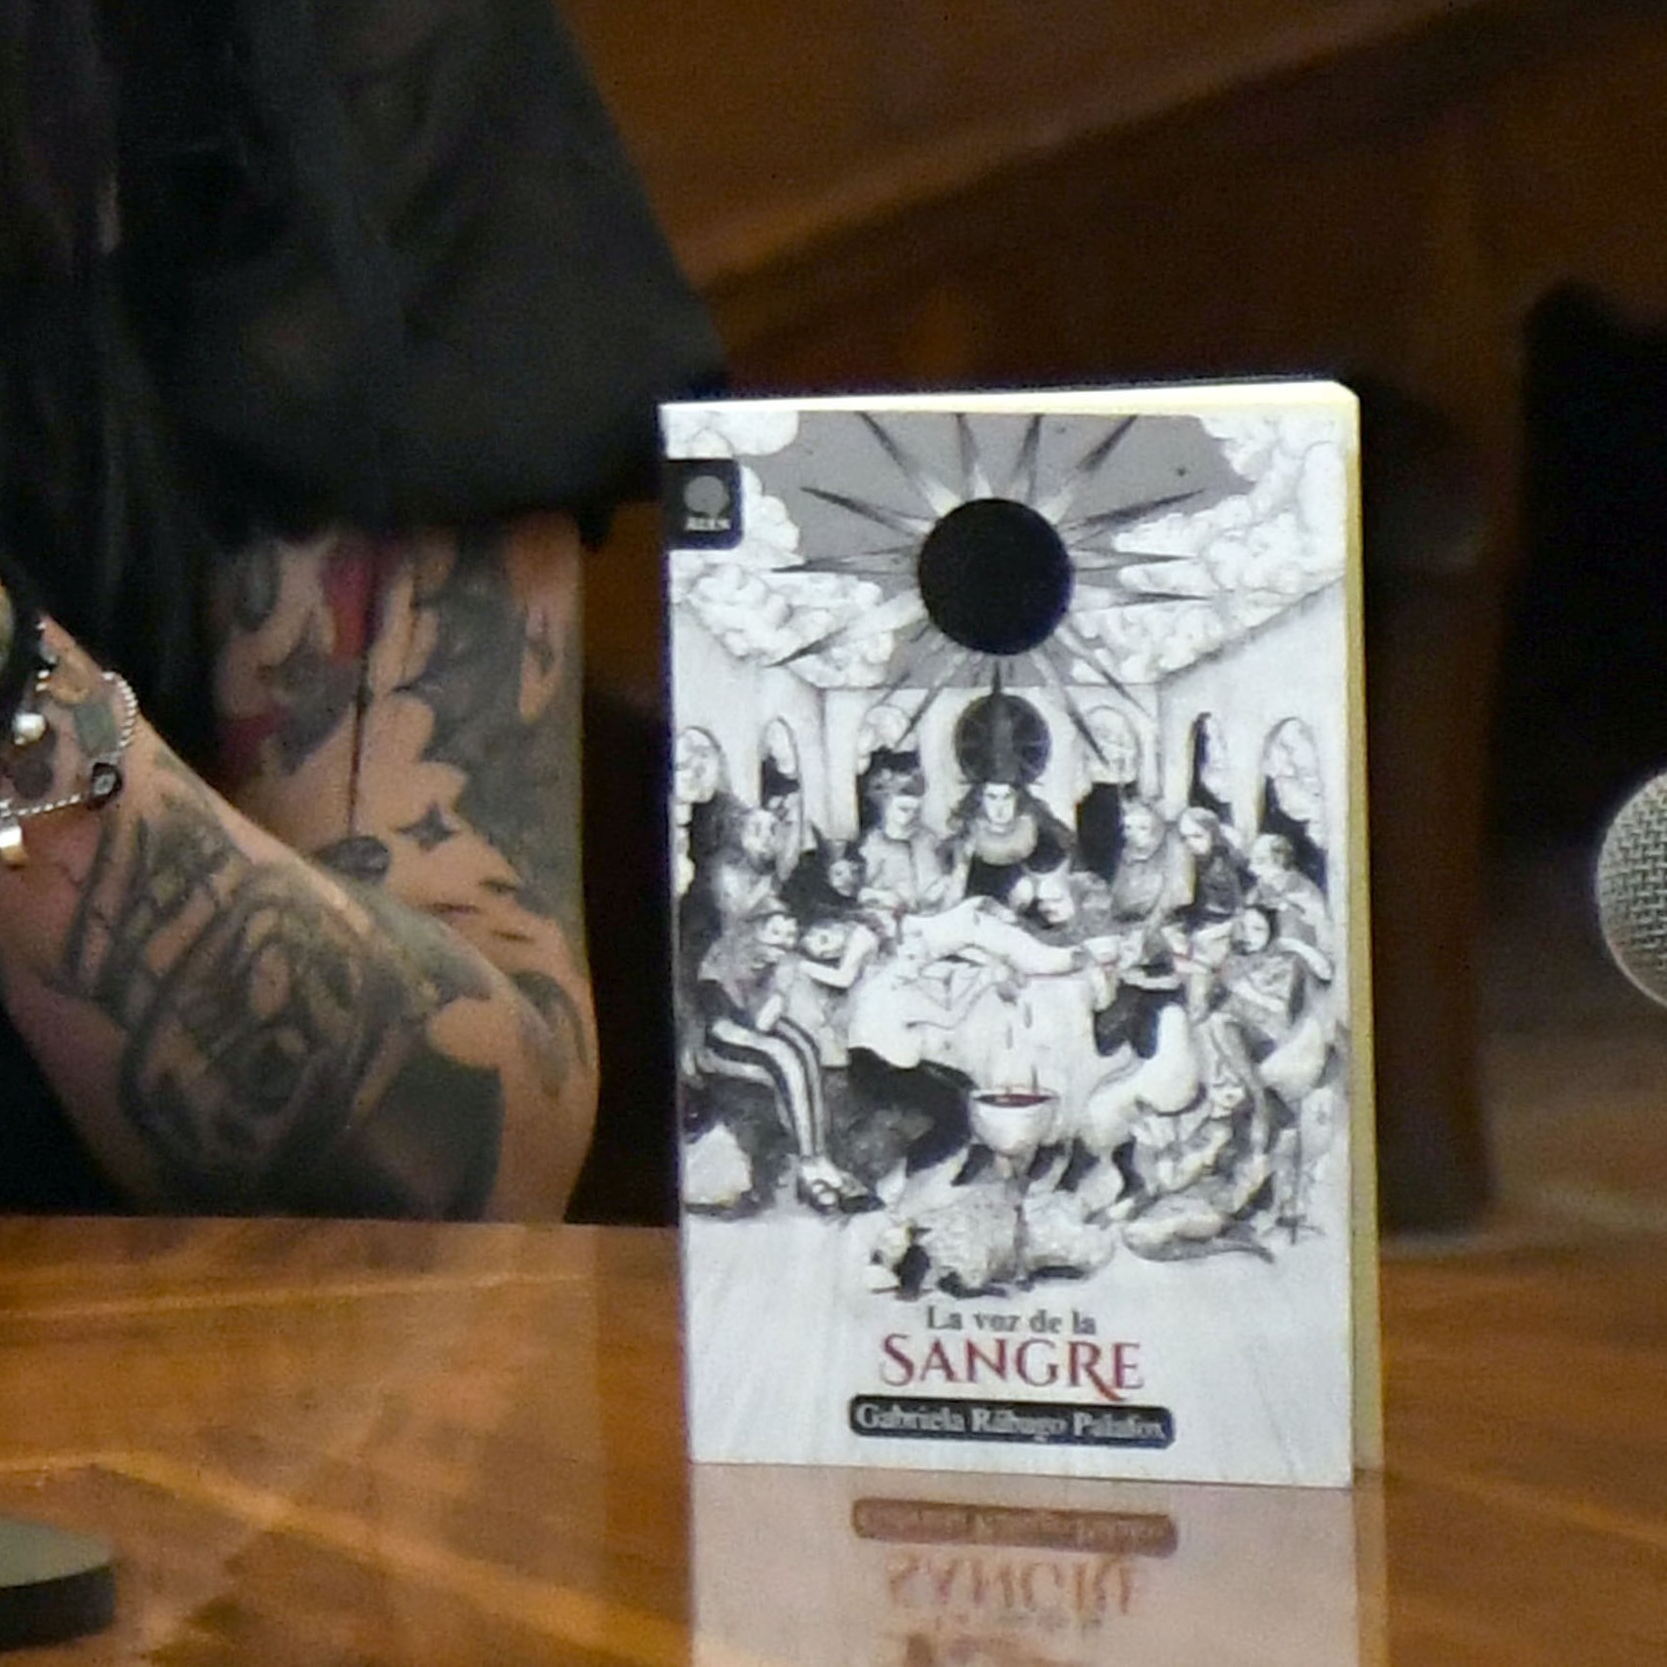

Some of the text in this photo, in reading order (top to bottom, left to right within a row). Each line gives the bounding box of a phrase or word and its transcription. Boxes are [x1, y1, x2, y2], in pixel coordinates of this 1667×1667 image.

[927, 1306, 1097, 1335] La voz de la
[880, 1333, 1145, 1402] SANGRE
[856, 1403, 965, 1432] Gabriela
